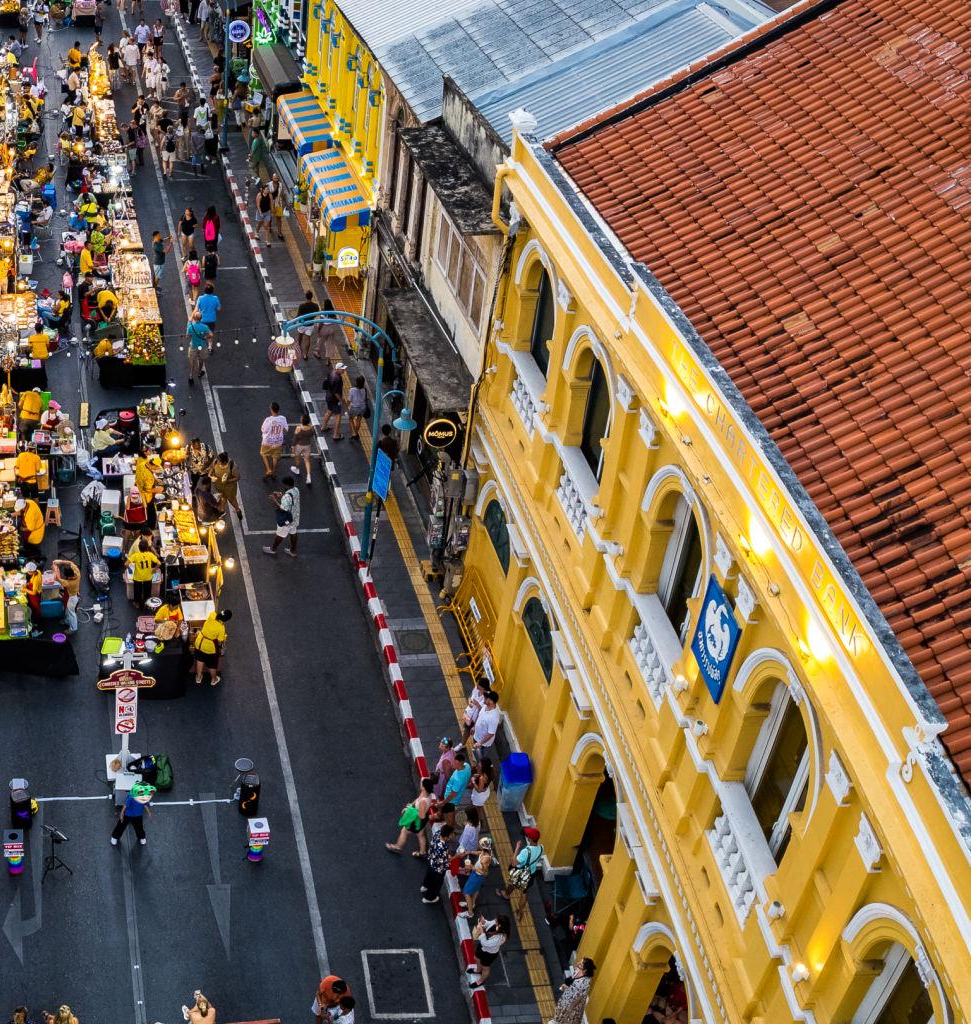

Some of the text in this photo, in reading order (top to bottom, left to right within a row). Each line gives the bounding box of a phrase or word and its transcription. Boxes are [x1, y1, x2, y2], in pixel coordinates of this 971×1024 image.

[140, 560, 149, 569] 11
[705, 391, 865, 658] CHARTERED BANK
